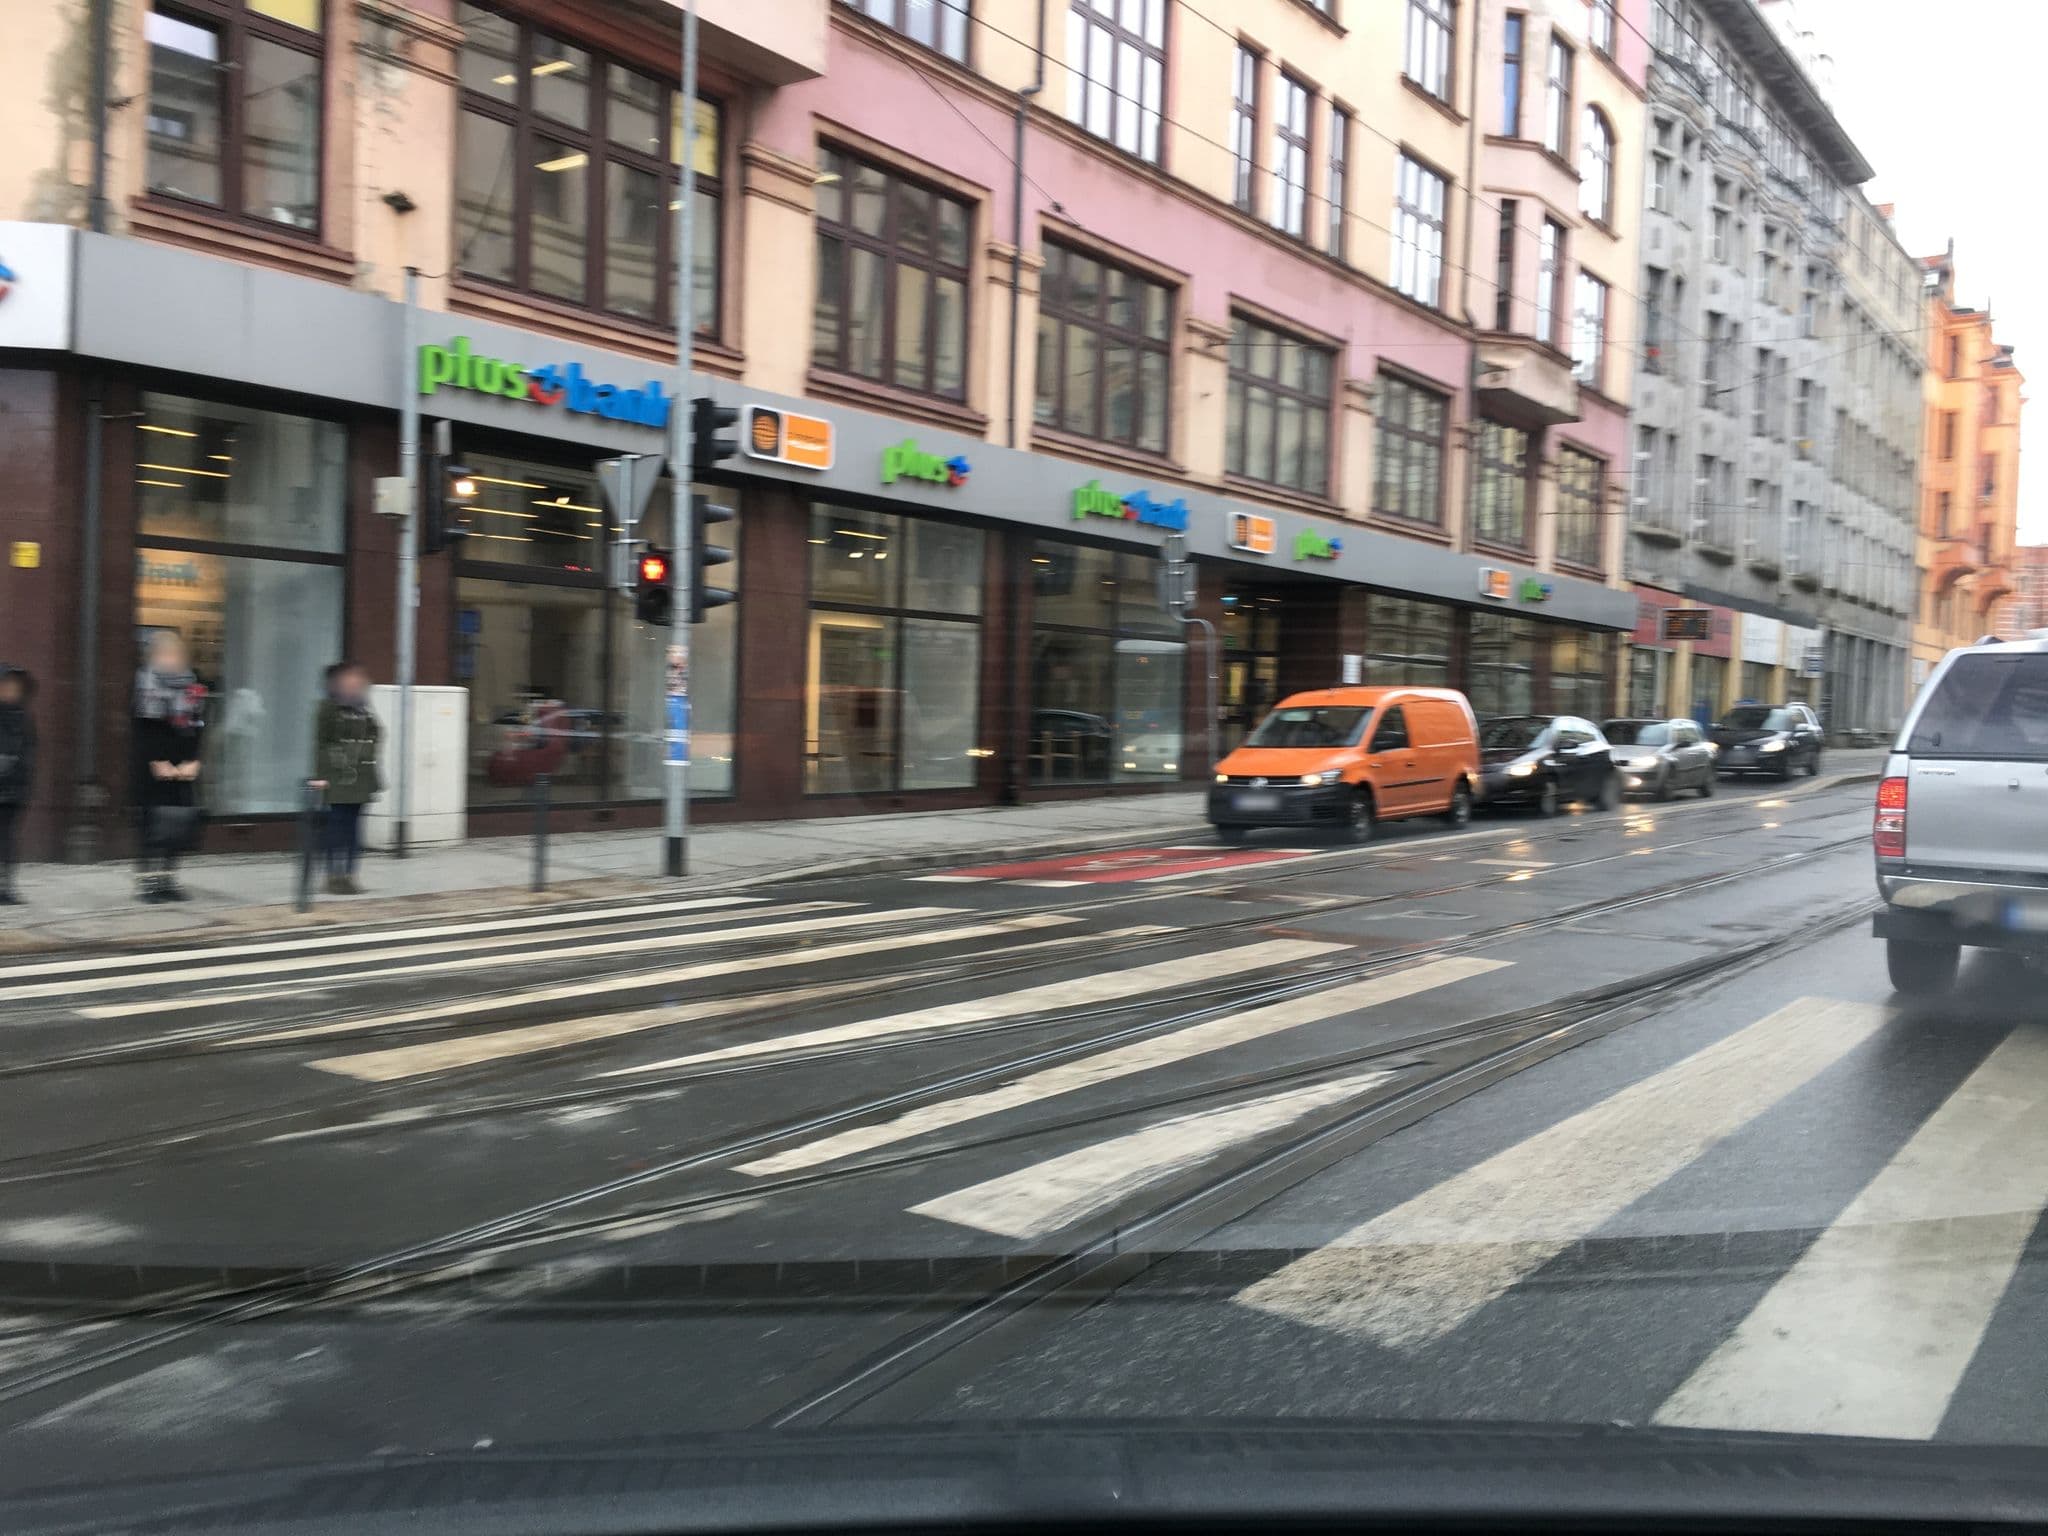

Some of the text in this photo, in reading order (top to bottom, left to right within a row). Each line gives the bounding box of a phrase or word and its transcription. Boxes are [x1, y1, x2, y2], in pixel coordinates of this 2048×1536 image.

[418, 336, 672, 428] plus bank
[881, 439, 949, 484] plus
[1073, 480, 1125, 519] plus
[1293, 528, 1332, 560] plus
